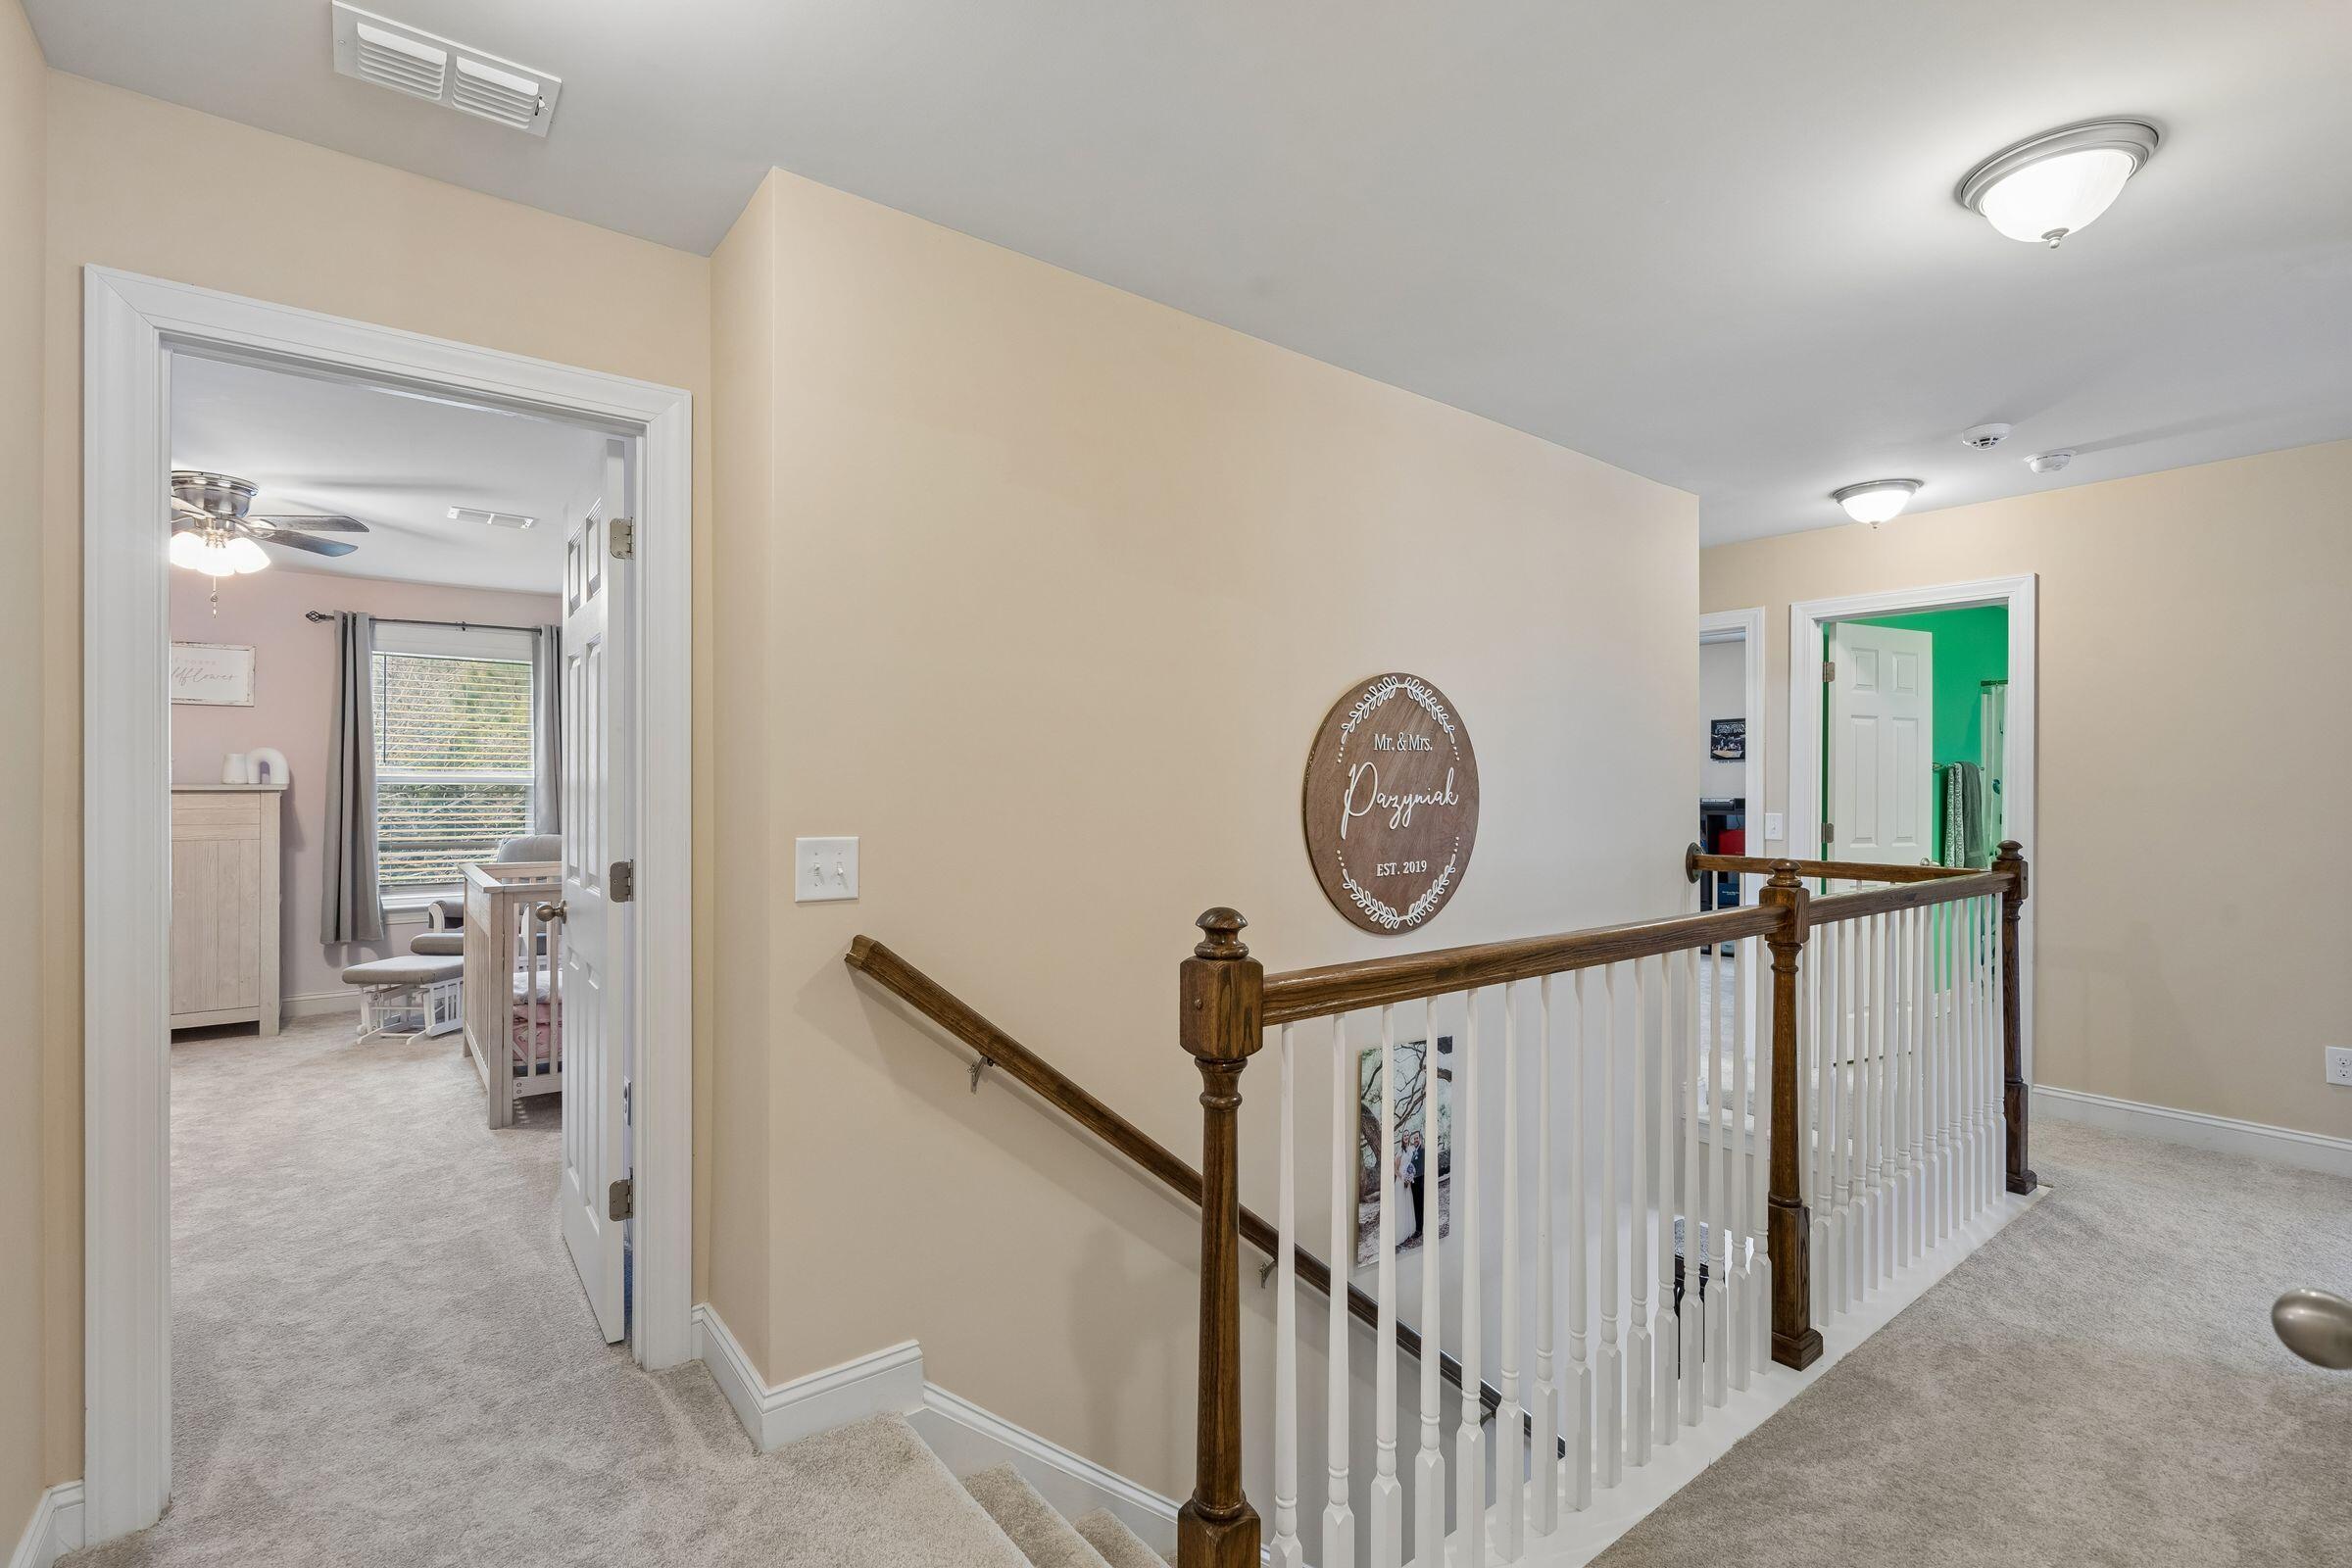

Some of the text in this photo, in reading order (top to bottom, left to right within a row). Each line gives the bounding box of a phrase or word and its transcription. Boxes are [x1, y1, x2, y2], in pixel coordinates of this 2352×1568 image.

[171, 666, 236, 686] ldflower
[1374, 732, 1433, 752] Mr. & Mrs.
[1341, 761, 1458, 840] Pazyniak
[1376, 859, 1427, 877] EST. 2019
